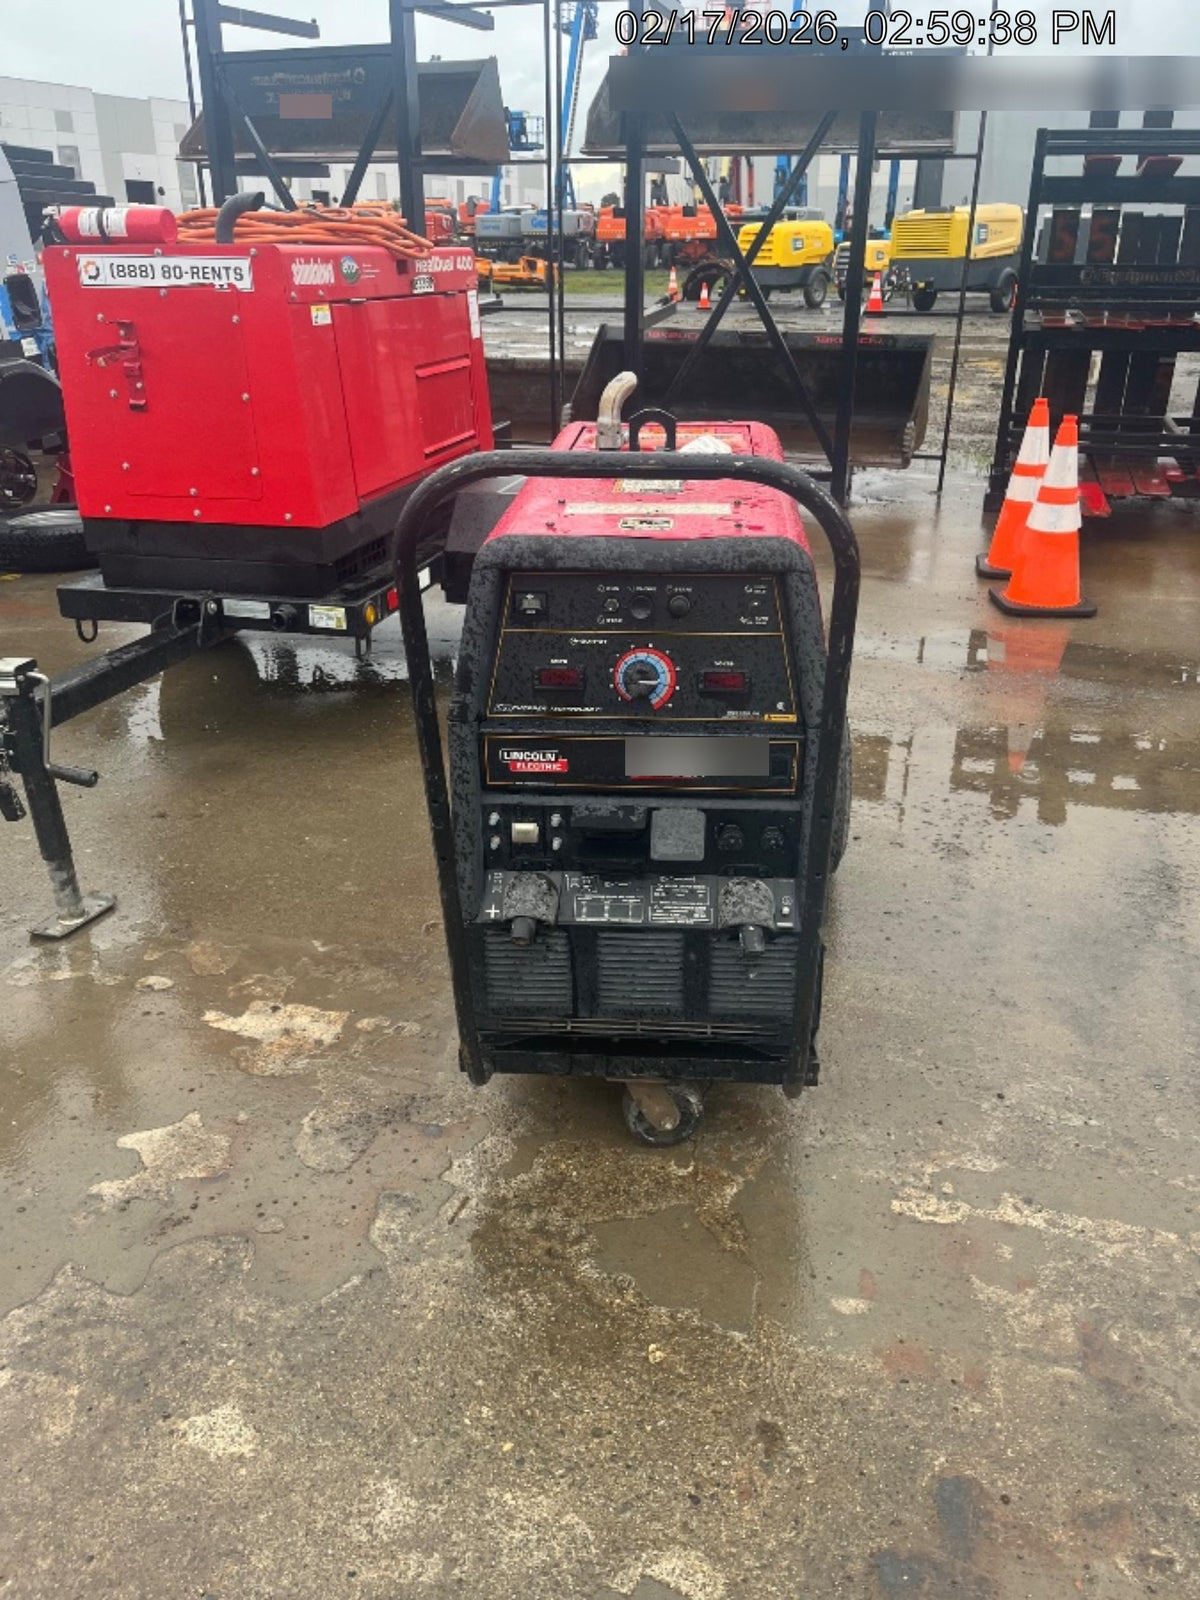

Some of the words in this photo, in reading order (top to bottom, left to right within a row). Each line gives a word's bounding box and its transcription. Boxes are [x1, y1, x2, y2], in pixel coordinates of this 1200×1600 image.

[109, 263, 156, 280] (888)
[161, 264, 244, 282] 80-RENTS
[503, 751, 556, 761] LINCOLN
[516, 762, 562, 771] ELECTRIC
